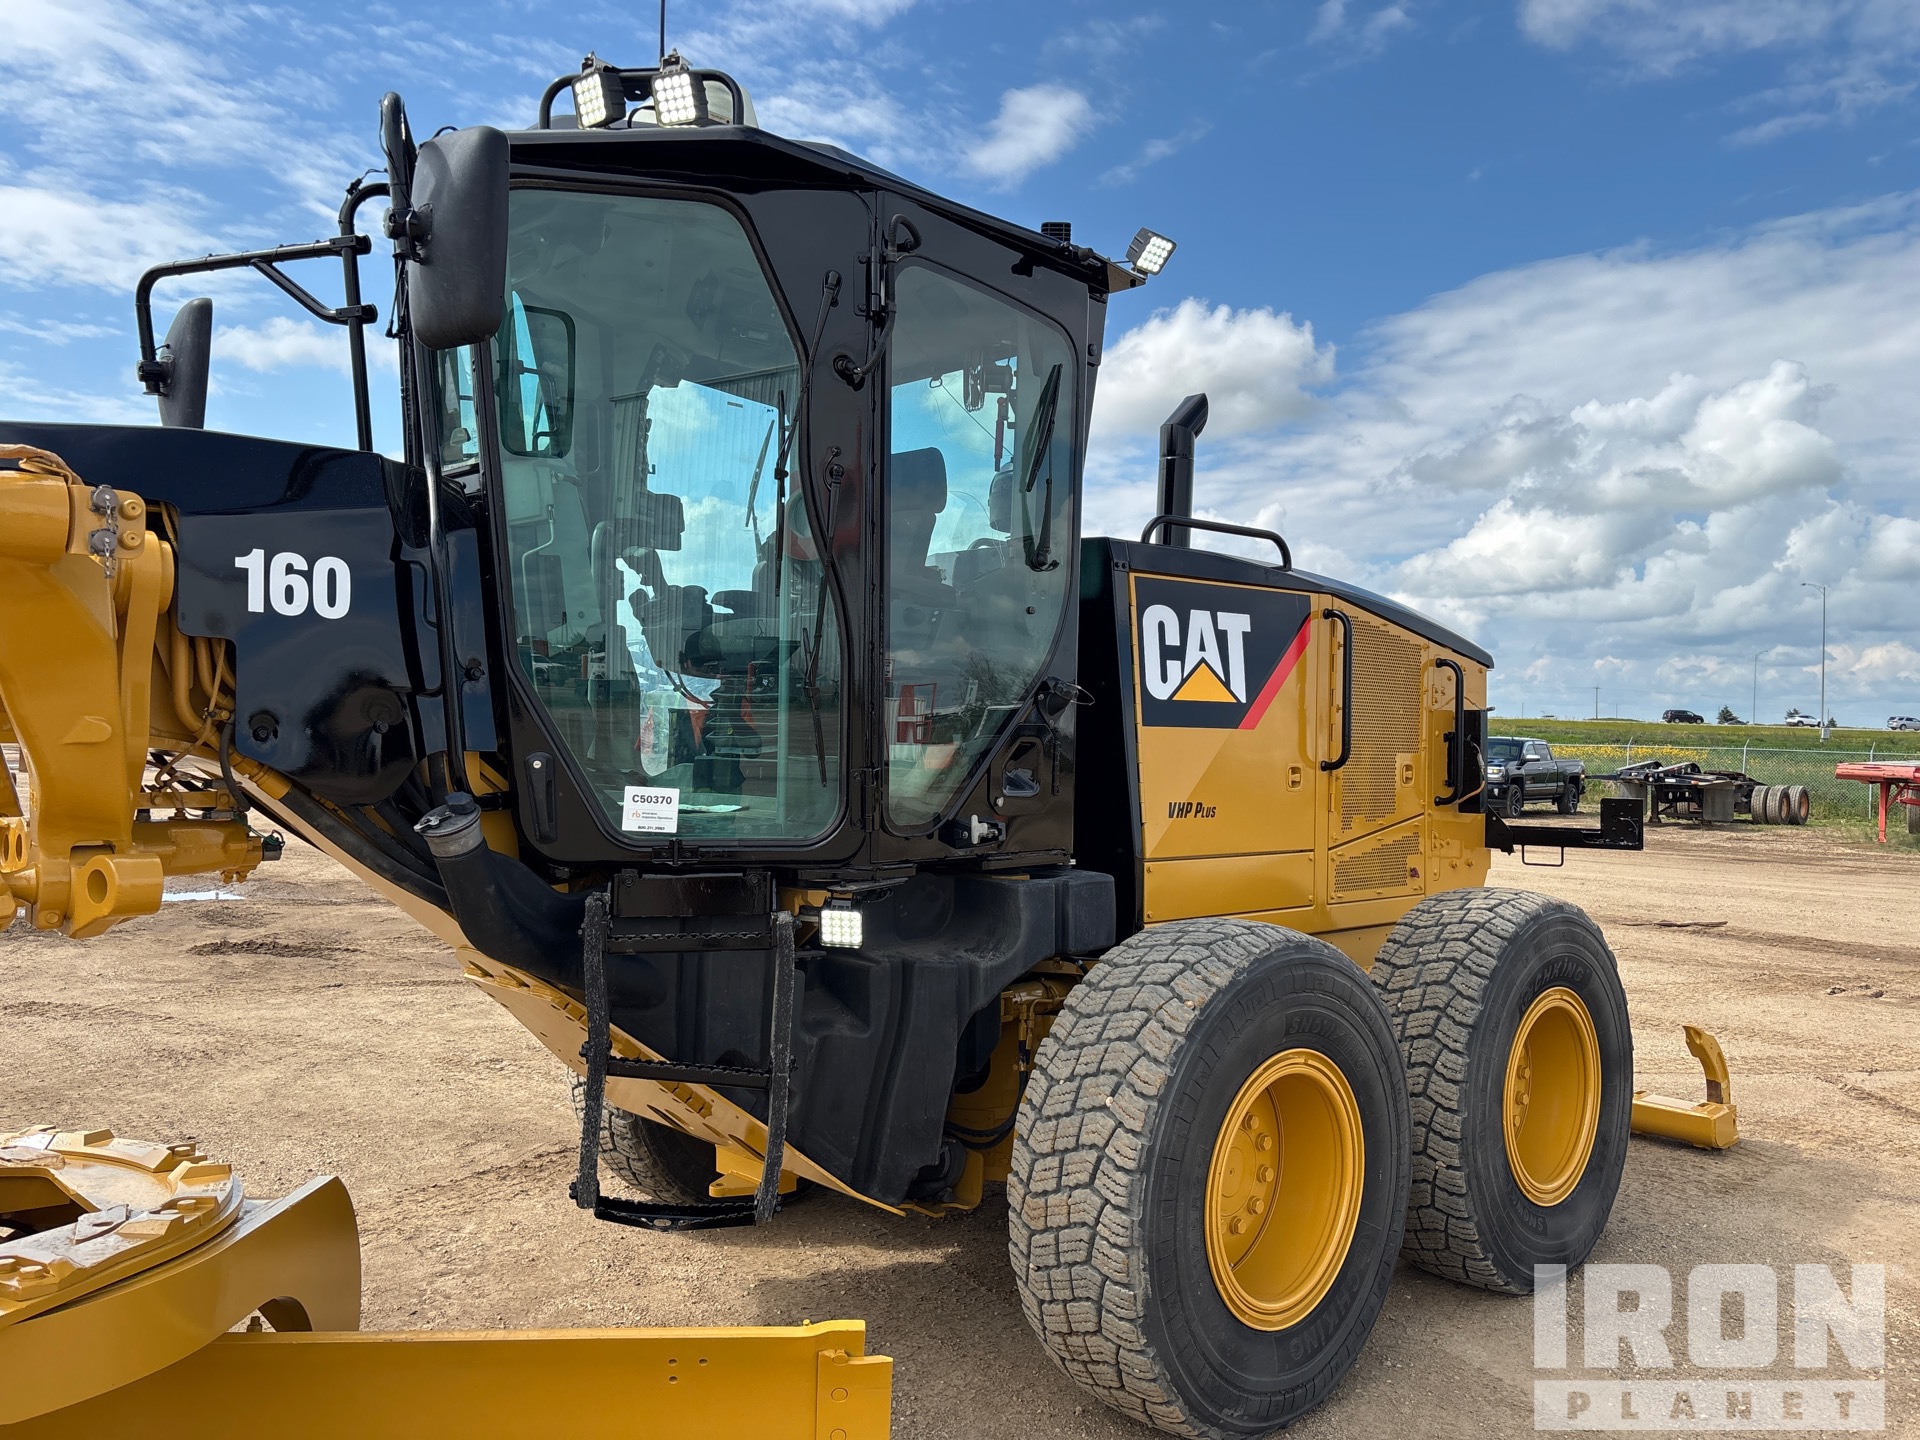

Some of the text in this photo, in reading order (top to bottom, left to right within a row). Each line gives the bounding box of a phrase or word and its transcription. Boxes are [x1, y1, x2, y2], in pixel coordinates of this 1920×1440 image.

[234, 548, 351, 620] 160
[1142, 604, 1252, 704] CAT
[631, 794, 673, 805] C50370
[1168, 802, 1192, 818] VHP
